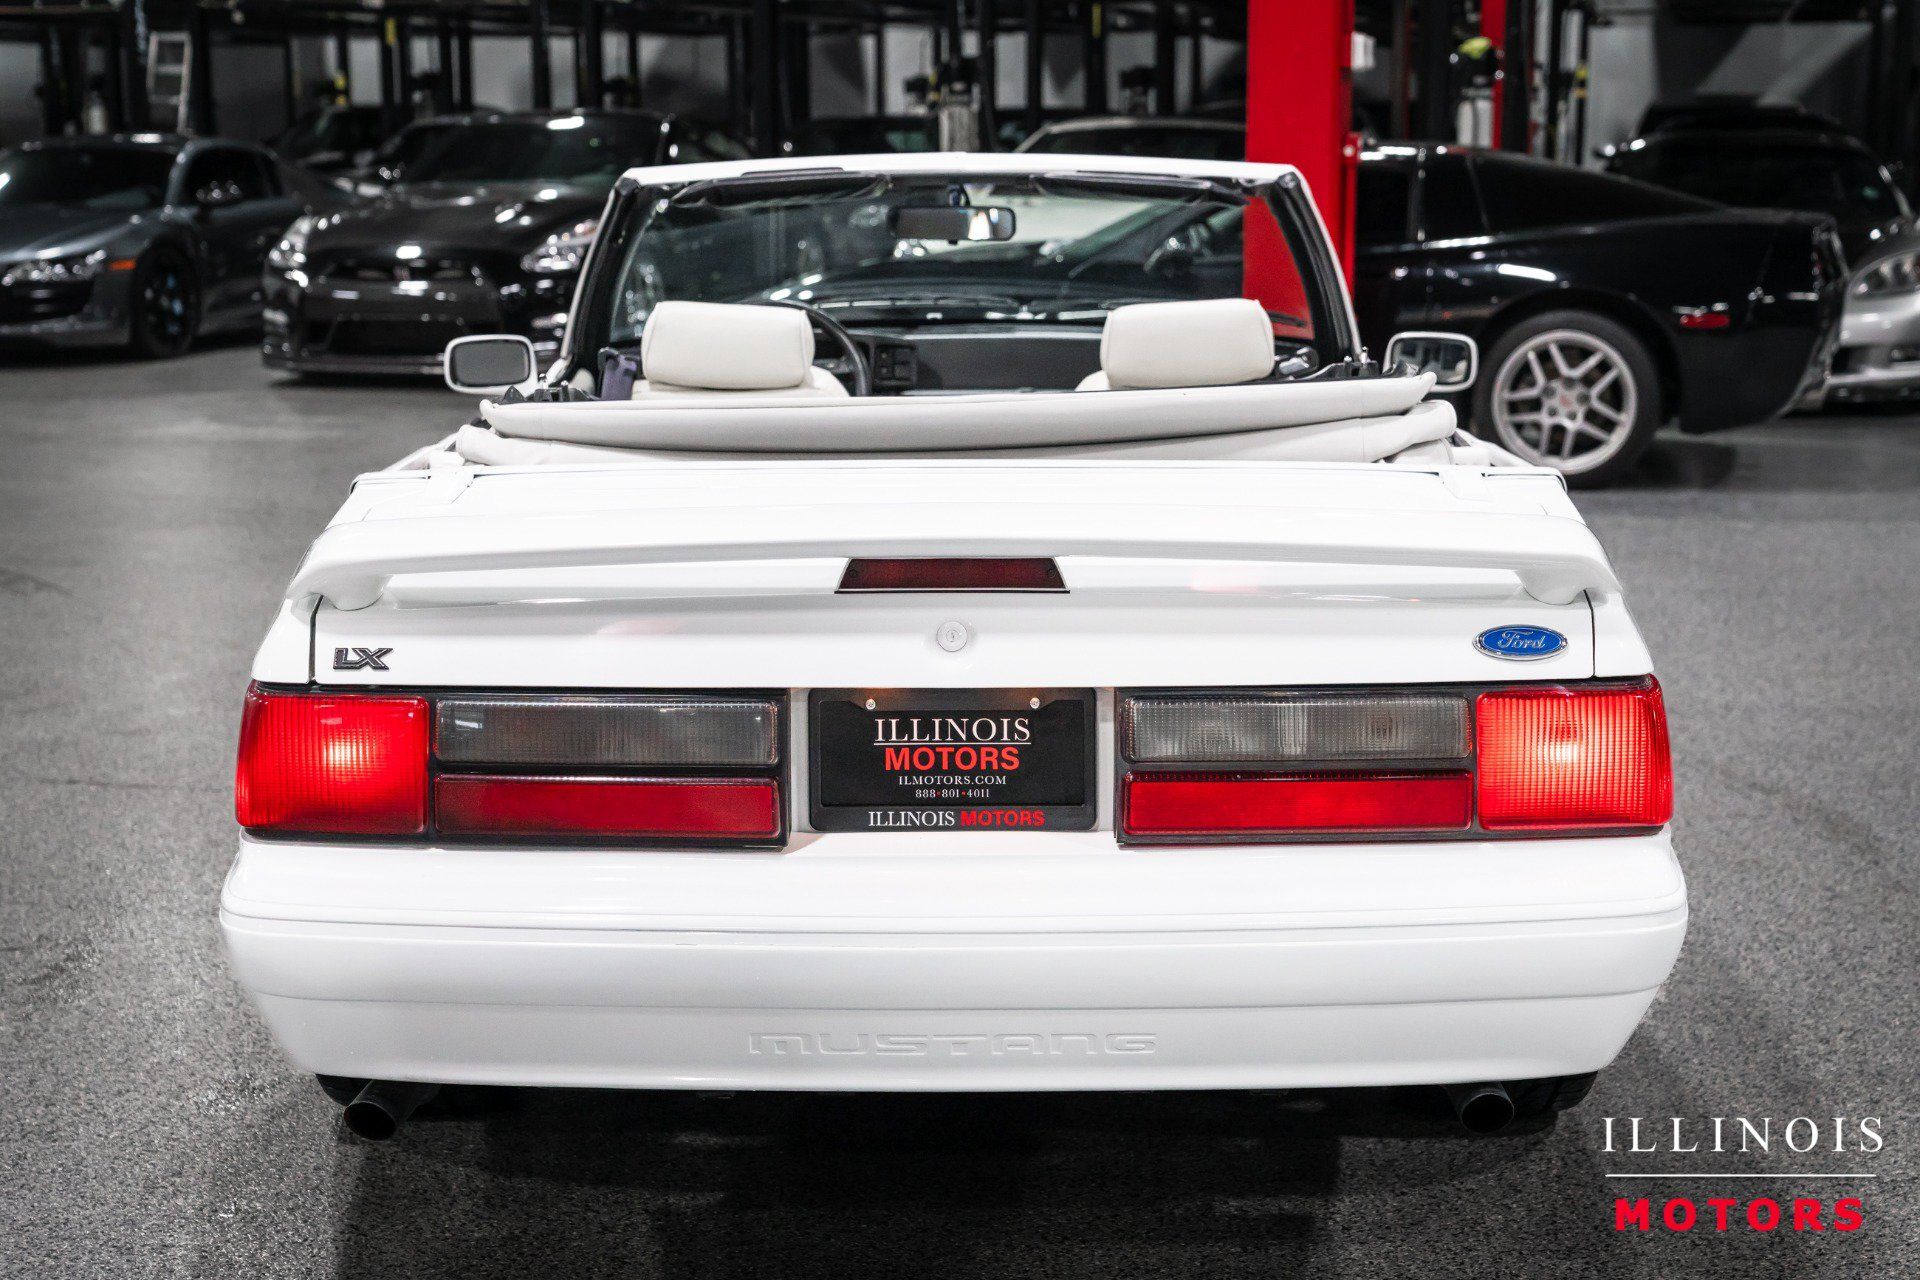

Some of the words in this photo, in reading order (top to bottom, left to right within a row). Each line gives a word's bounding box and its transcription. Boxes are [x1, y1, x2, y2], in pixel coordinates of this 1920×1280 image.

[1497, 630, 1546, 649] Ford
[333, 647, 393, 670] LX
[874, 718, 1031, 742] ILLINOIS
[884, 746, 1020, 771] MOTORS
[899, 775, 1007, 785] ILMOTORS.COM
[868, 810, 955, 827] ILLINOIS
[960, 810, 1046, 827] MOTORS
[748, 1032, 1157, 1055] MUSTANG
